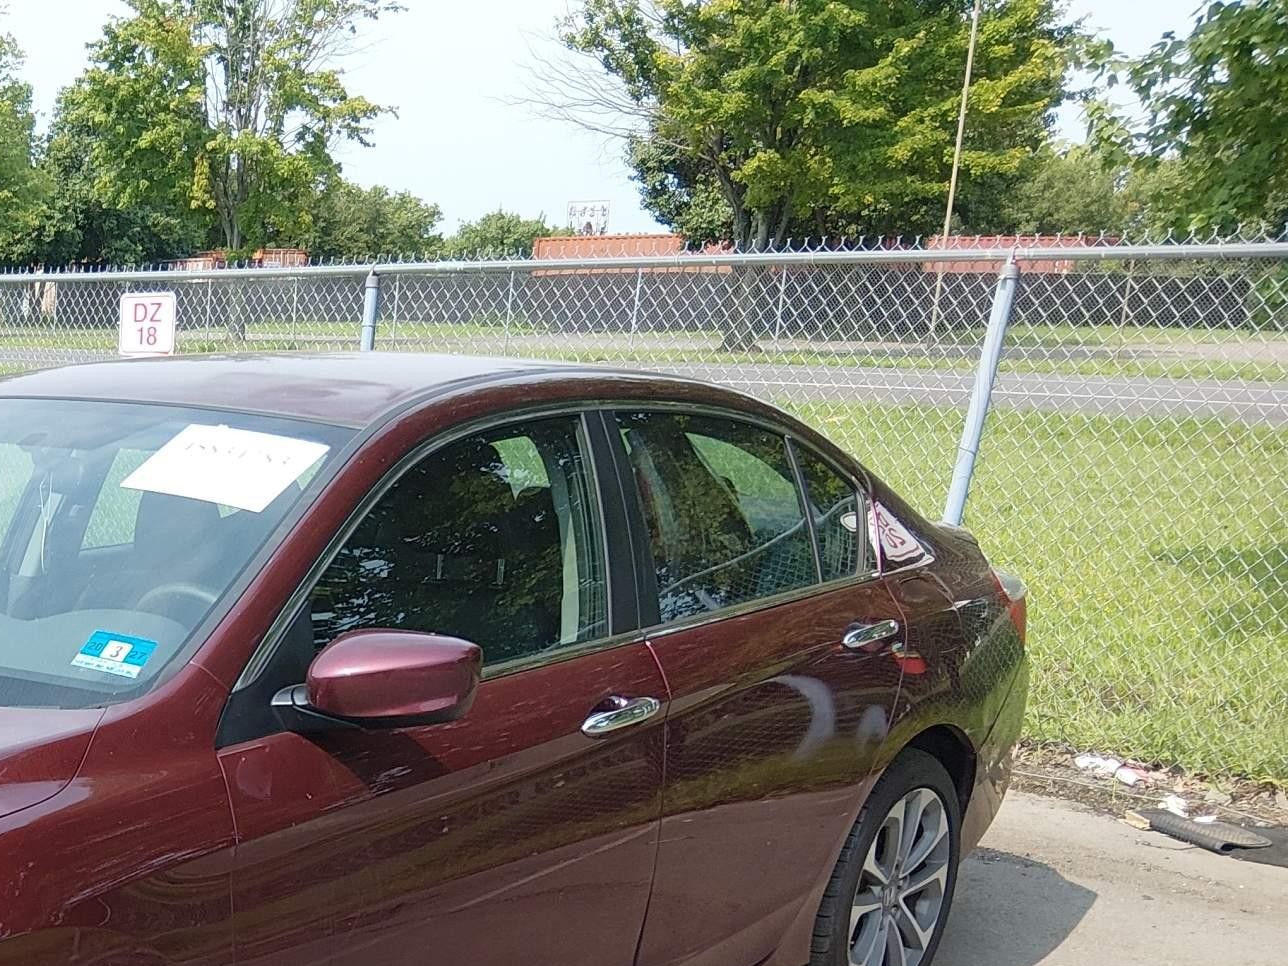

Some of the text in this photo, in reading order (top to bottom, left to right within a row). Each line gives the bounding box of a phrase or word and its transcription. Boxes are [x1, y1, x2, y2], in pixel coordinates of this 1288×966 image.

[133, 302, 163, 323] DZ
[137, 326, 158, 346] 18
[88, 641, 103, 652] 20
[109, 645, 124, 659] 3
